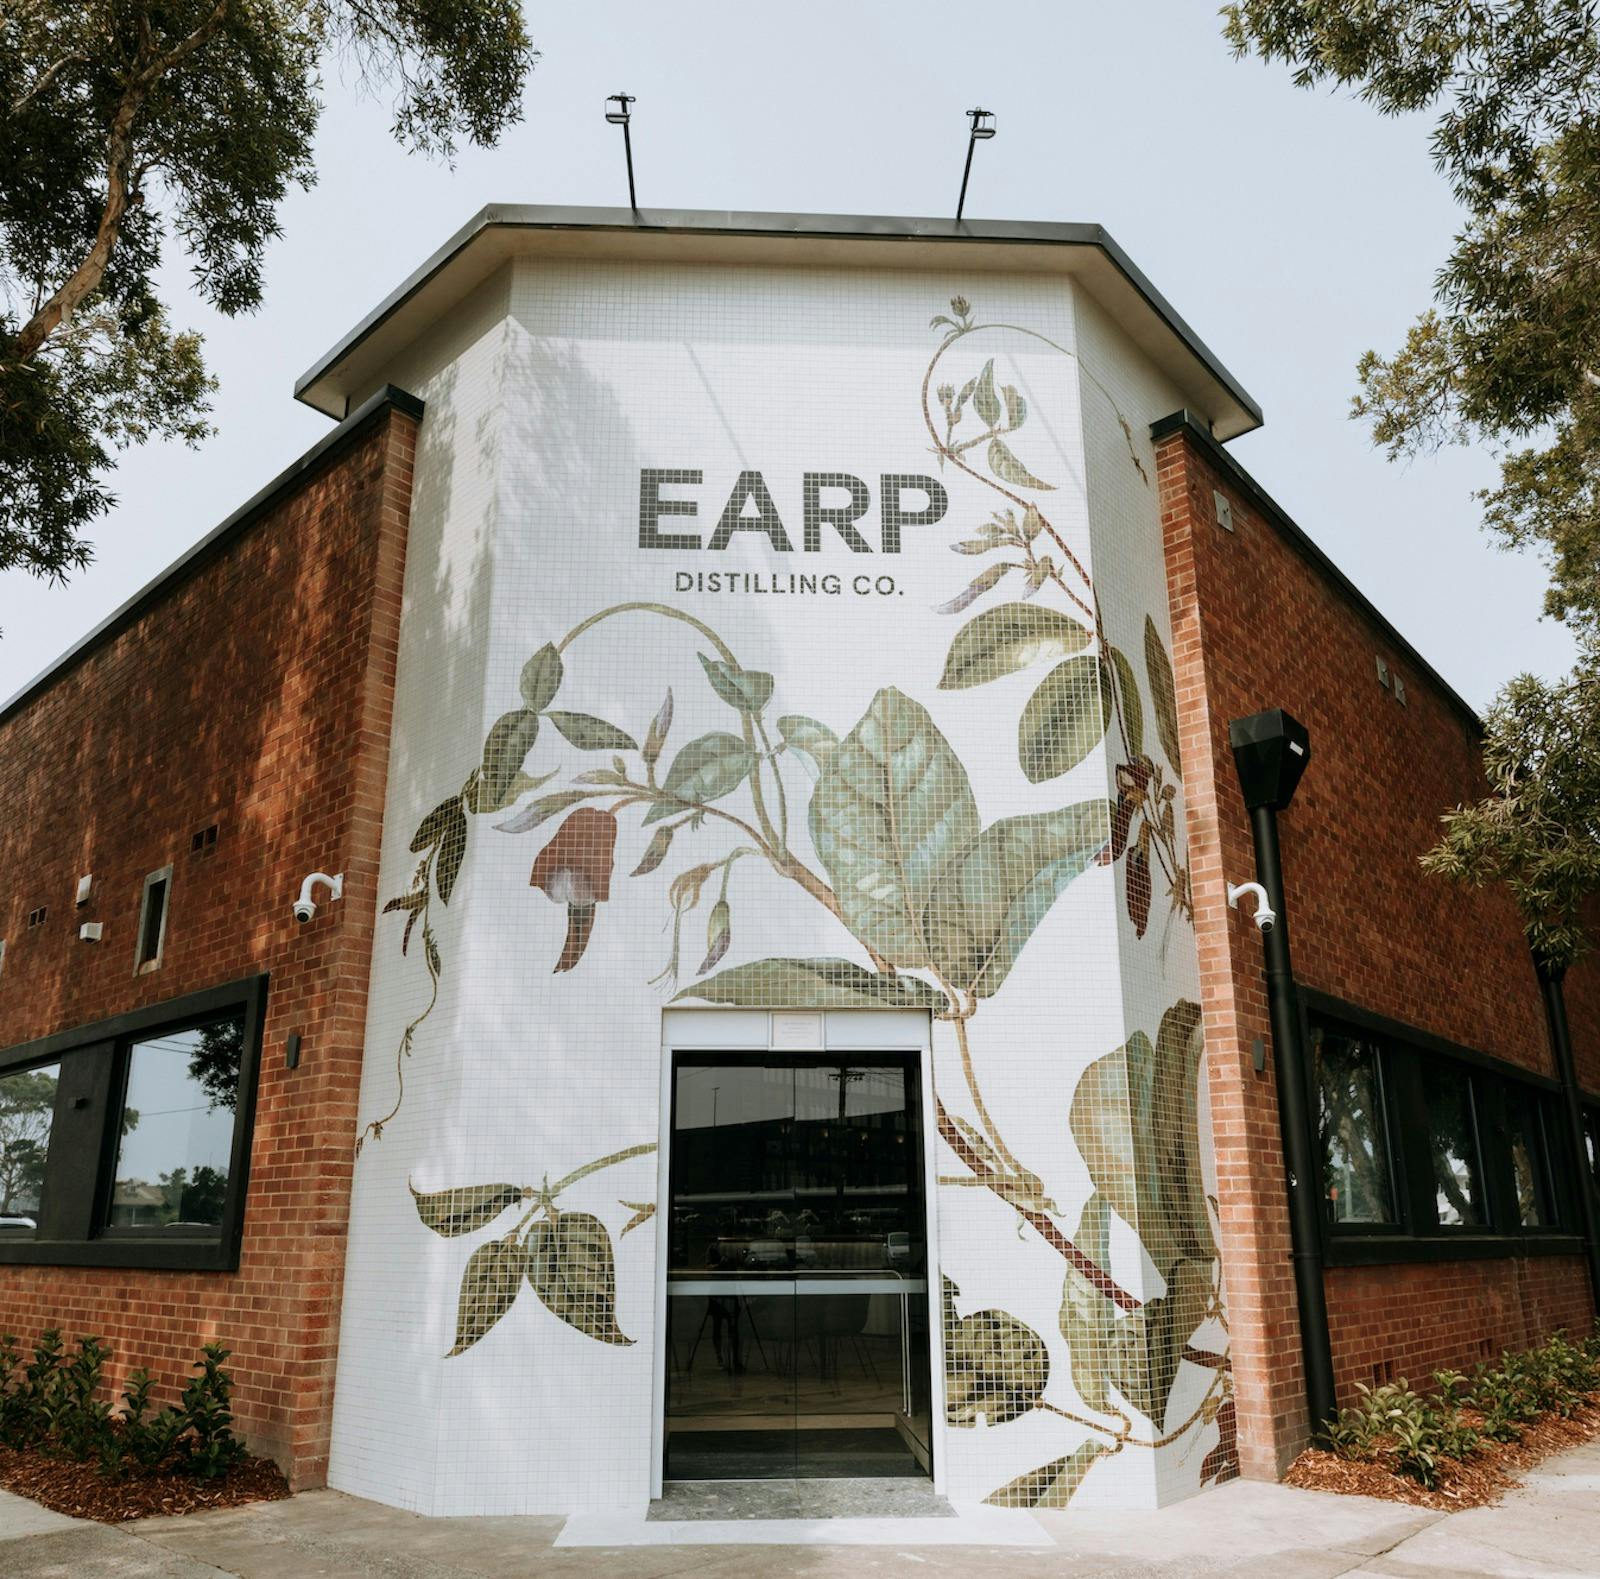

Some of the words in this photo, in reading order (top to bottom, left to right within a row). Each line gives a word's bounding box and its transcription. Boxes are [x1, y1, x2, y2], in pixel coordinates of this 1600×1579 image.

[639, 468, 949, 554] EARP
[675, 572, 841, 595] DISTILLING
[852, 575, 904, 596] CO.
